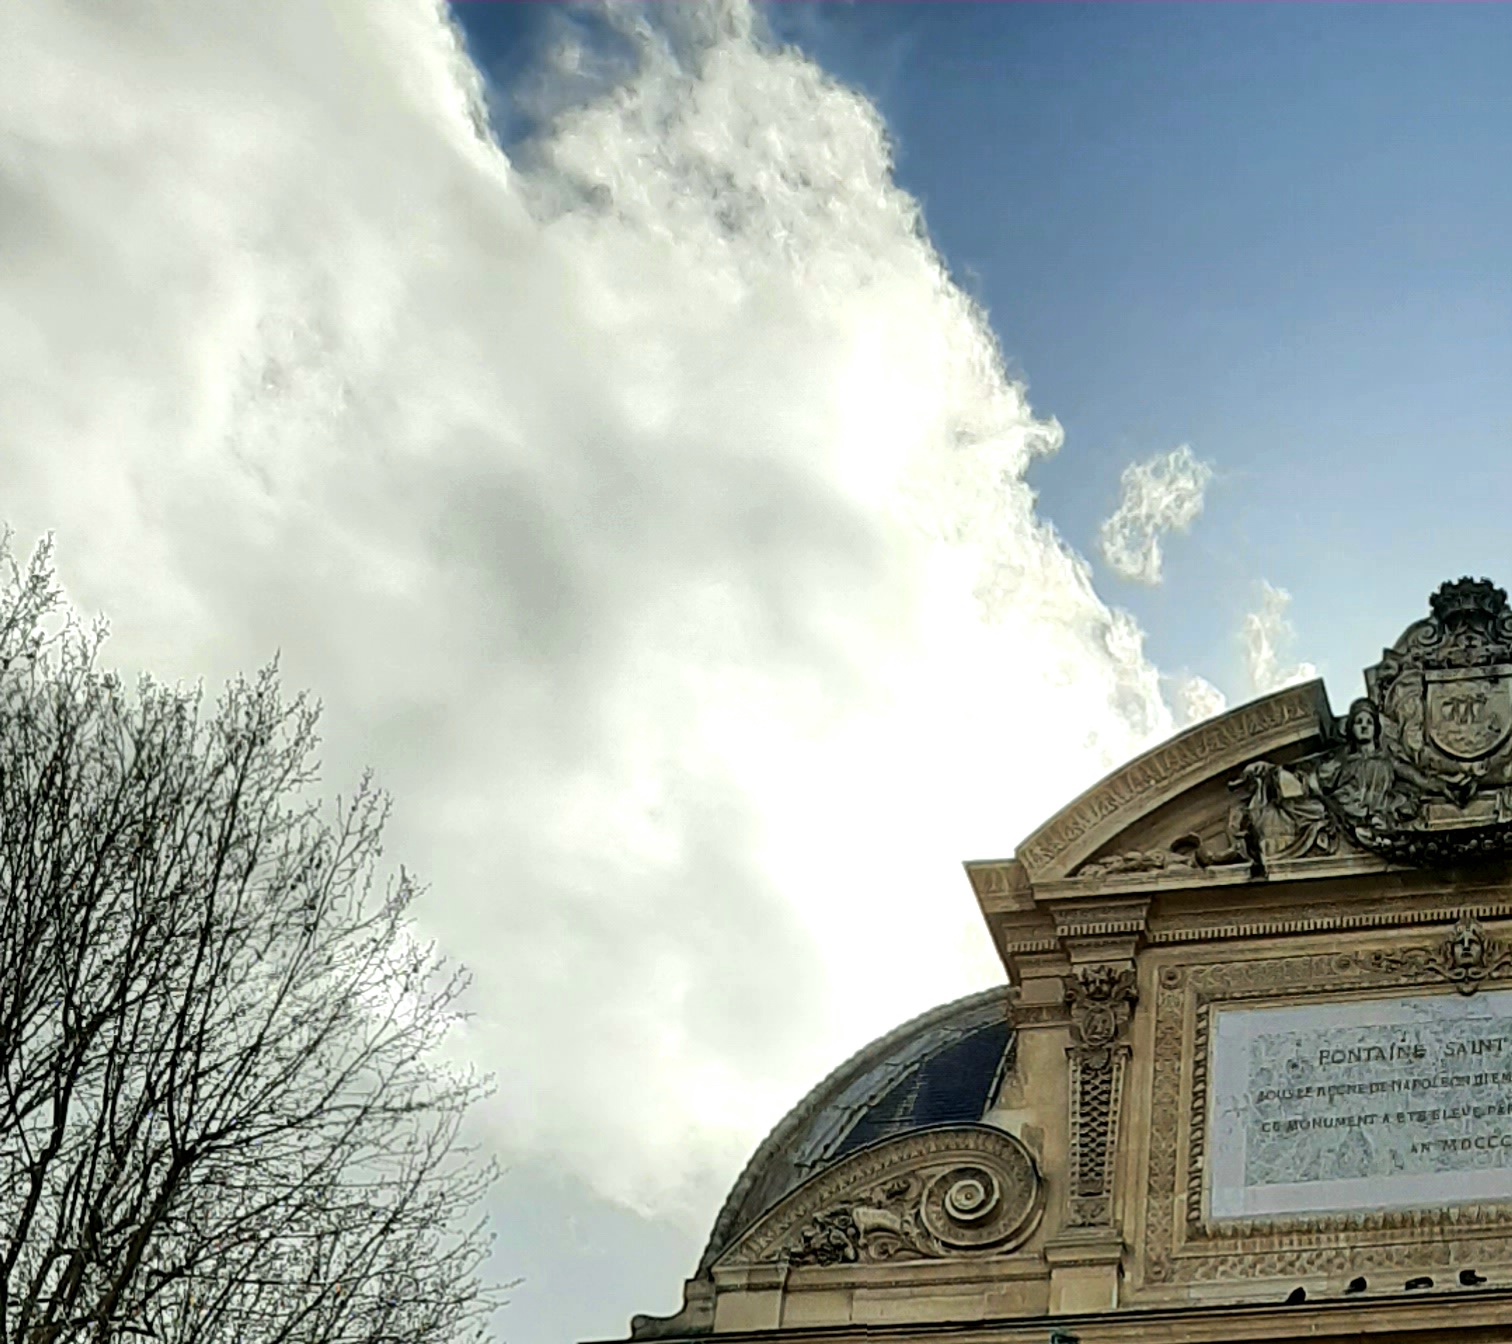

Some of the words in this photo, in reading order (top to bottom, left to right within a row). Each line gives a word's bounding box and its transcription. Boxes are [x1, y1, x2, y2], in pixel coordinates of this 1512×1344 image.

[1319, 1042, 1427, 1066] FONTAINE
[1443, 1037, 1507, 1057] SAINT
[1370, 1080, 1387, 1094] DE
[1261, 1120, 1281, 1133] CE
[1285, 1113, 1378, 1132] MONUMENT
[1382, 1112, 1390, 1123] A
